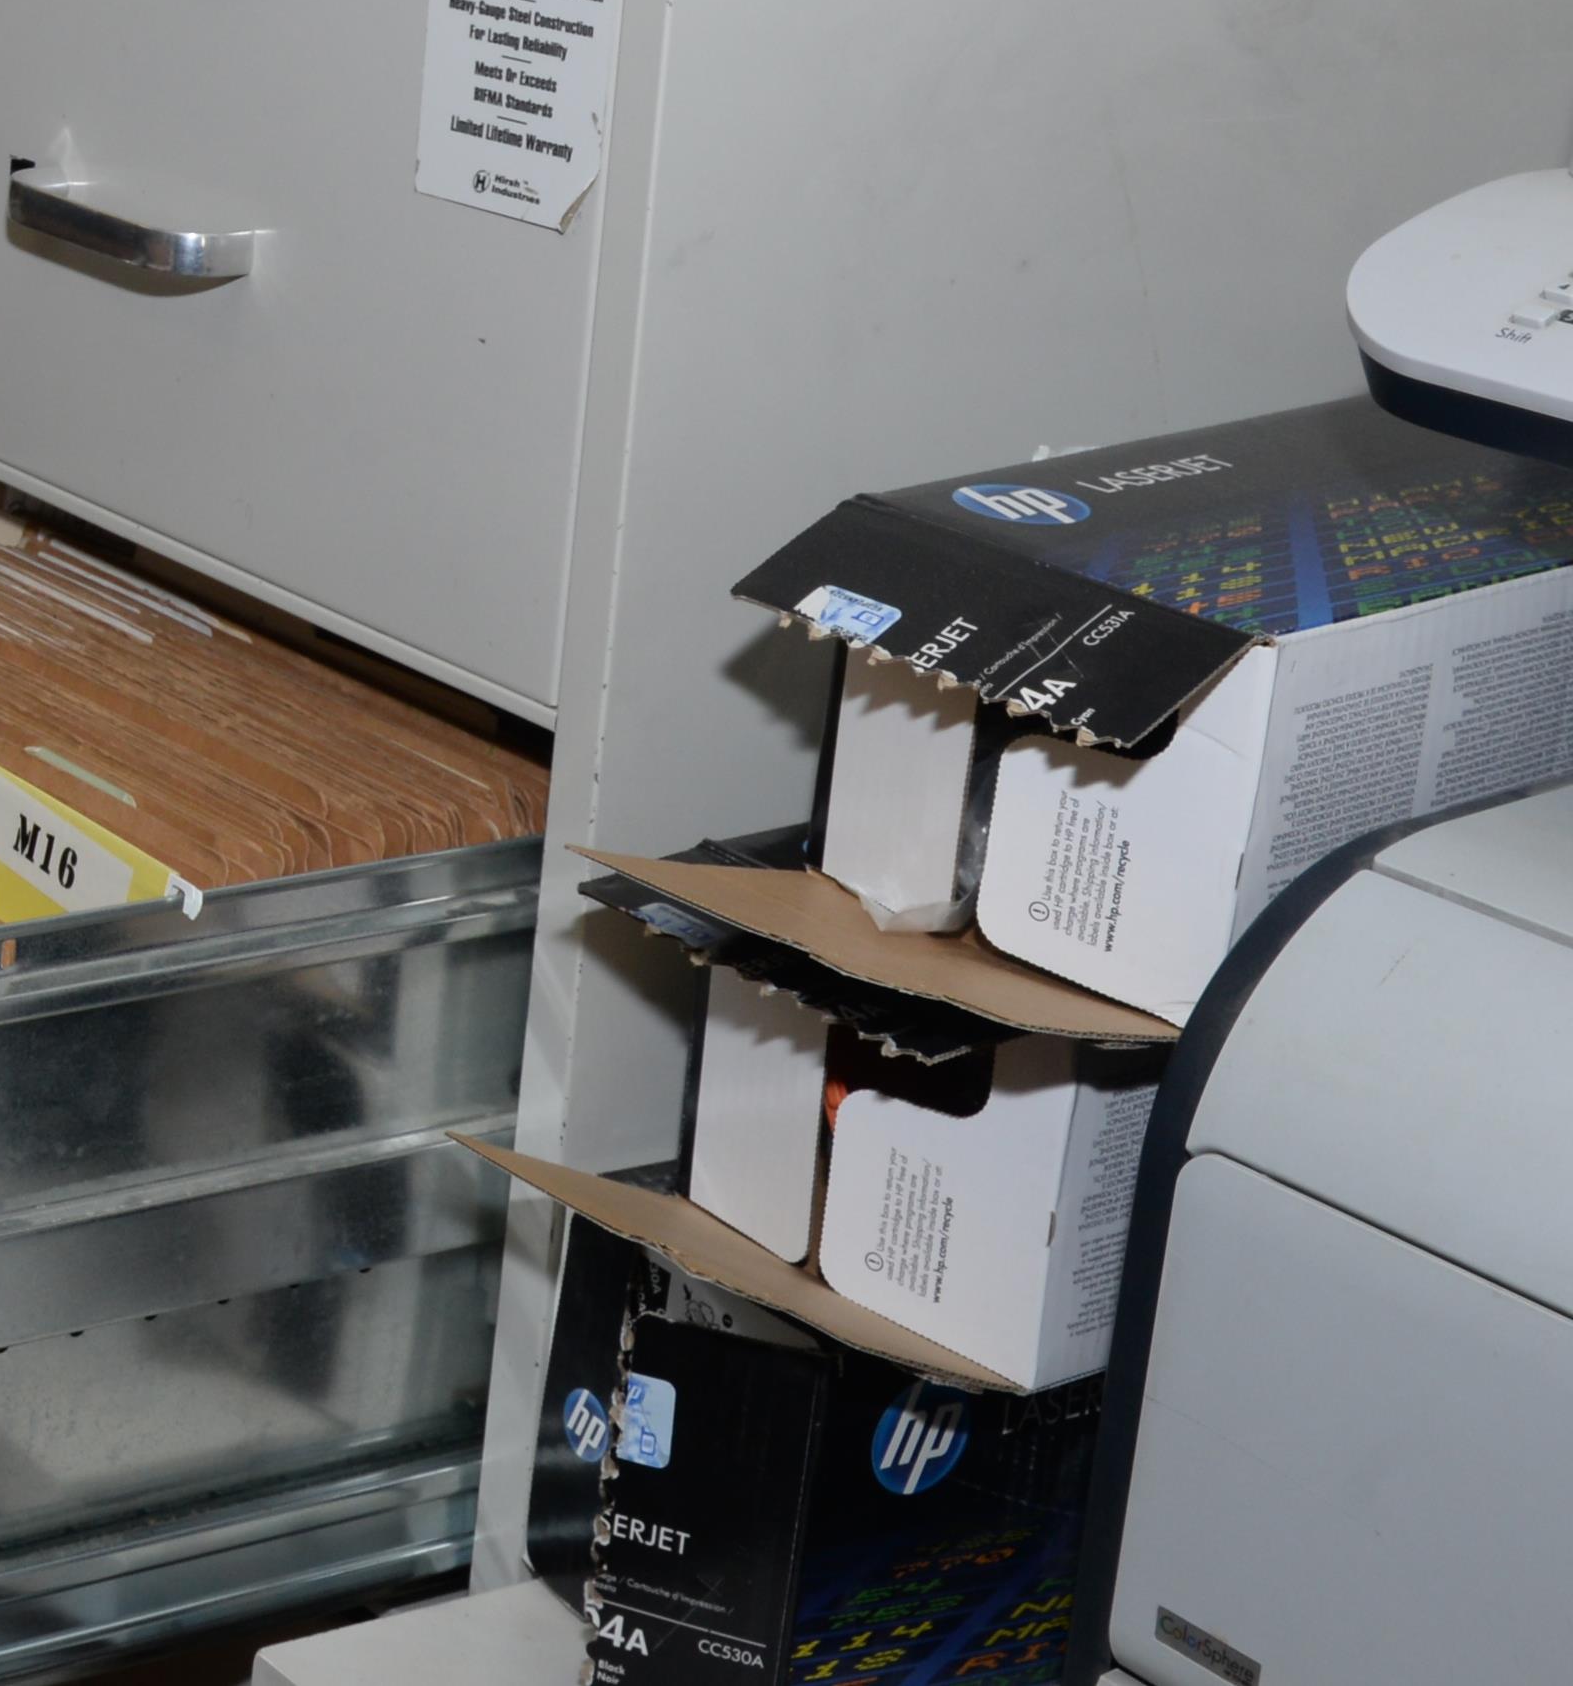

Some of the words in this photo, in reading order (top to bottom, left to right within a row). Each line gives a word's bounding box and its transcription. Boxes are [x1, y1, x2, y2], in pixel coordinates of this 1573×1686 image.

[509, 6, 532, 26] Steel
[534, 11, 594, 38] Construction
[469, 25, 486, 40] For
[488, 29, 520, 51] Lasting
[522, 35, 568, 61] Reliability
[475, 60, 503, 81] Meets
[506, 67, 517, 82] Or
[520, 71, 557, 93] Exceeds
[474, 87, 503, 107] BIFMA
[506, 94, 553, 119] Standards
[451, 115, 483, 138] Limited
[486, 124, 522, 149] Lifetime
[526, 134, 573, 163] Warranty
[495, 175, 520, 188] Hirsh
[957, 485, 1077, 524] hp
[1077, 454, 1233, 494] LASERJET
[1083, 610, 1136, 646] CC531A
[1070, 708, 1096, 726] Cyan
[12, 813, 80, 891] M16
[1104, 840, 1131, 952] www.hp.com/recycle
[933, 1197, 954, 1303] www.hp.com/recycle
[565, 1388, 606, 1457] hp
[880, 1379, 963, 1495] hp
[698, 1639, 765, 1669] CC530A
[1160, 1615, 1255, 1683] ColorSphere
[597, 1671, 620, 1684] Noir
[598, 1660, 626, 1675] Black
